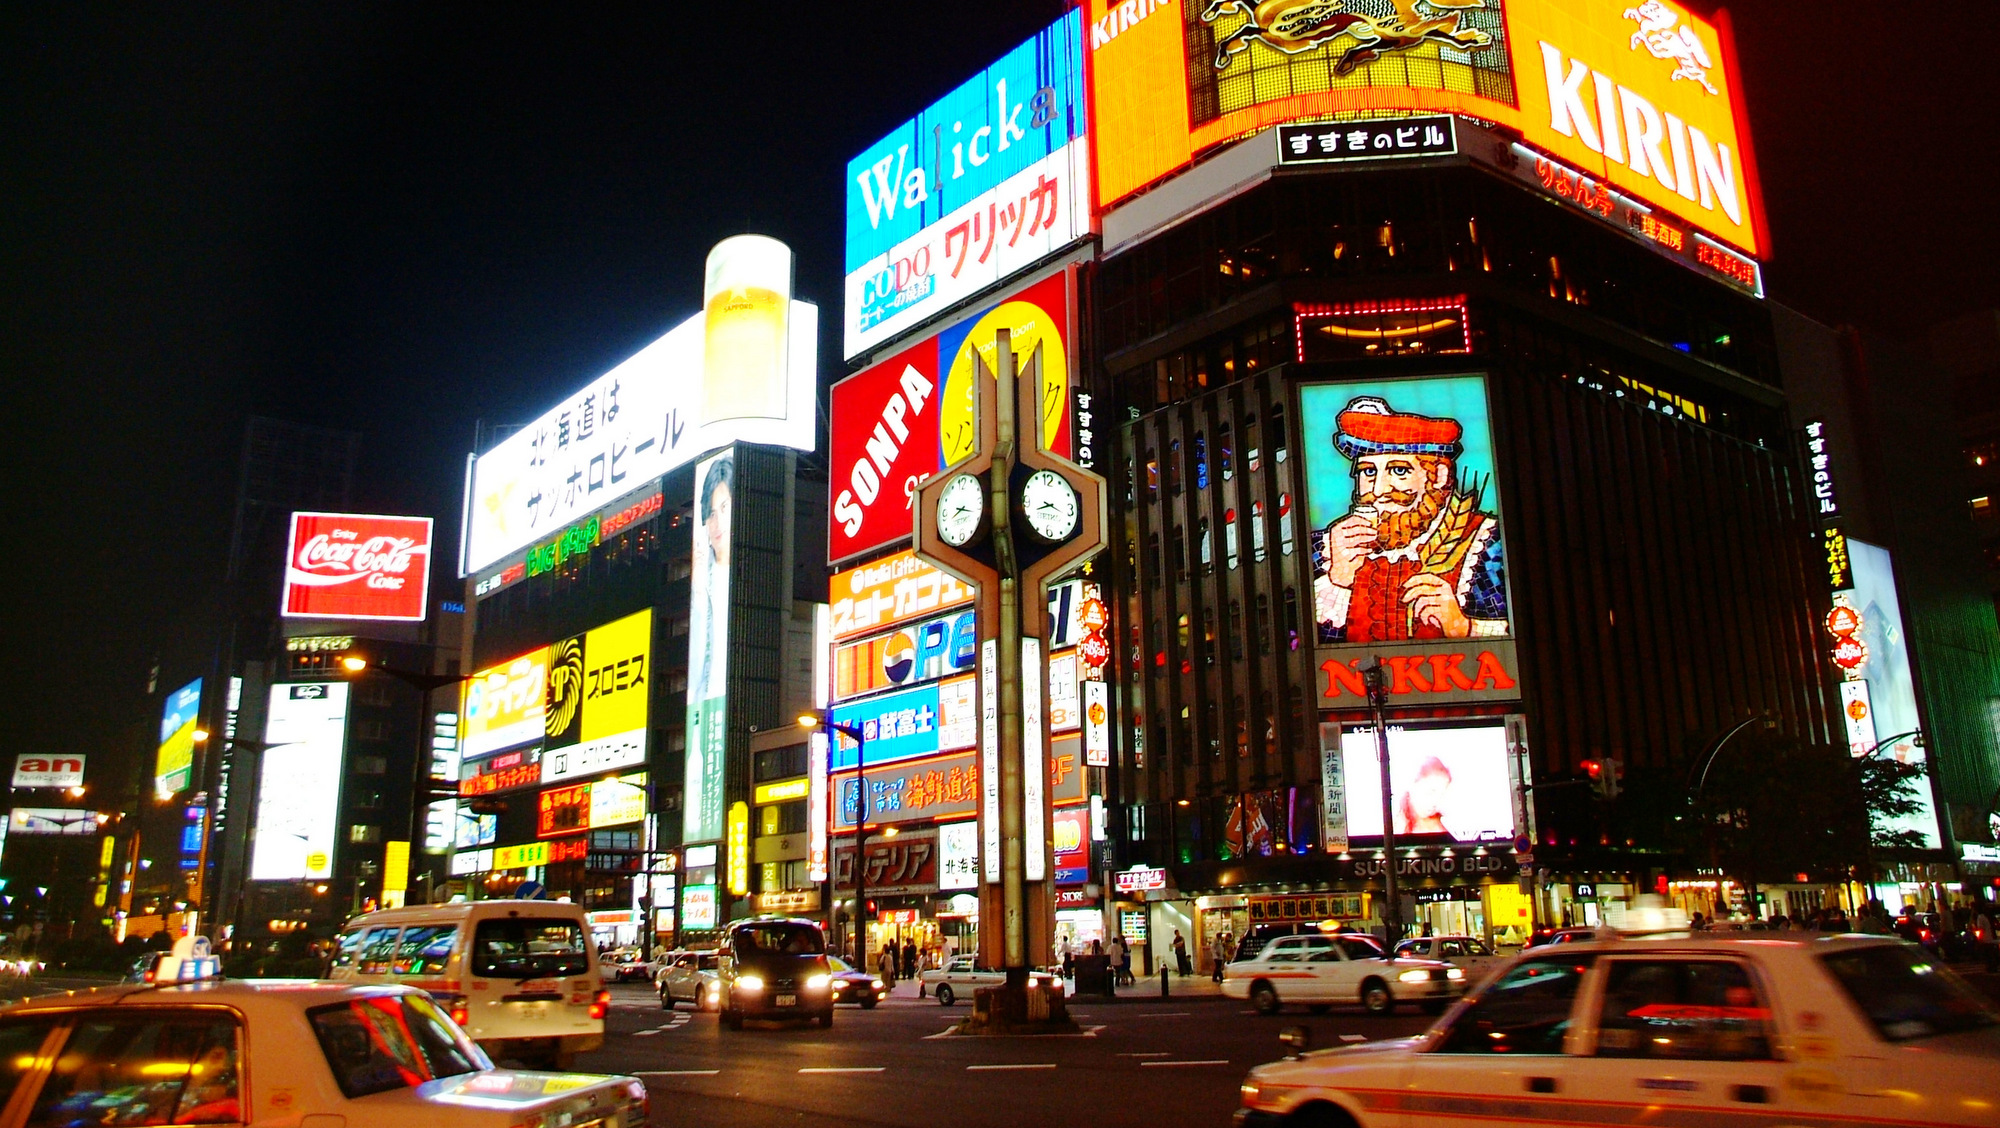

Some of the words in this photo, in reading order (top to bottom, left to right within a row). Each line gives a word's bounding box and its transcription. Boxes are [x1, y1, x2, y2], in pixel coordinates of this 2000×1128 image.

[857, 77, 1060, 229] Walicka
[1289, 126, 1444, 155] すすきのビル
[1539, 40, 1741, 226] KIRIN
[1535, 157, 1616, 217] りょん亭
[945, 174, 1058, 279] ワリッカ
[860, 246, 931, 308] GODO
[530, 379, 621, 467] 北海道は
[527, 408, 685, 528] サッポロビール
[834, 363, 934, 538] SONPA
[1805, 422, 1836, 513] すすきのビル
[1042, 474, 1054, 487] 12
[1045, 524, 1054, 538] 6
[1067, 503, 1075, 517] 3
[299, 533, 415, 573] Coca-Cola
[366, 573, 405, 590] Coke
[588, 653, 646, 701] プロミス
[878, 704, 935, 740] 武富士
[20, 758, 82, 772] an
[1326, 751, 1342, 815] 北海道新聞
[1354, 857, 1455, 877] SUSUKINO
[1463, 856, 1508, 873] BLD.
[1062, 891, 1084, 902] STORE
